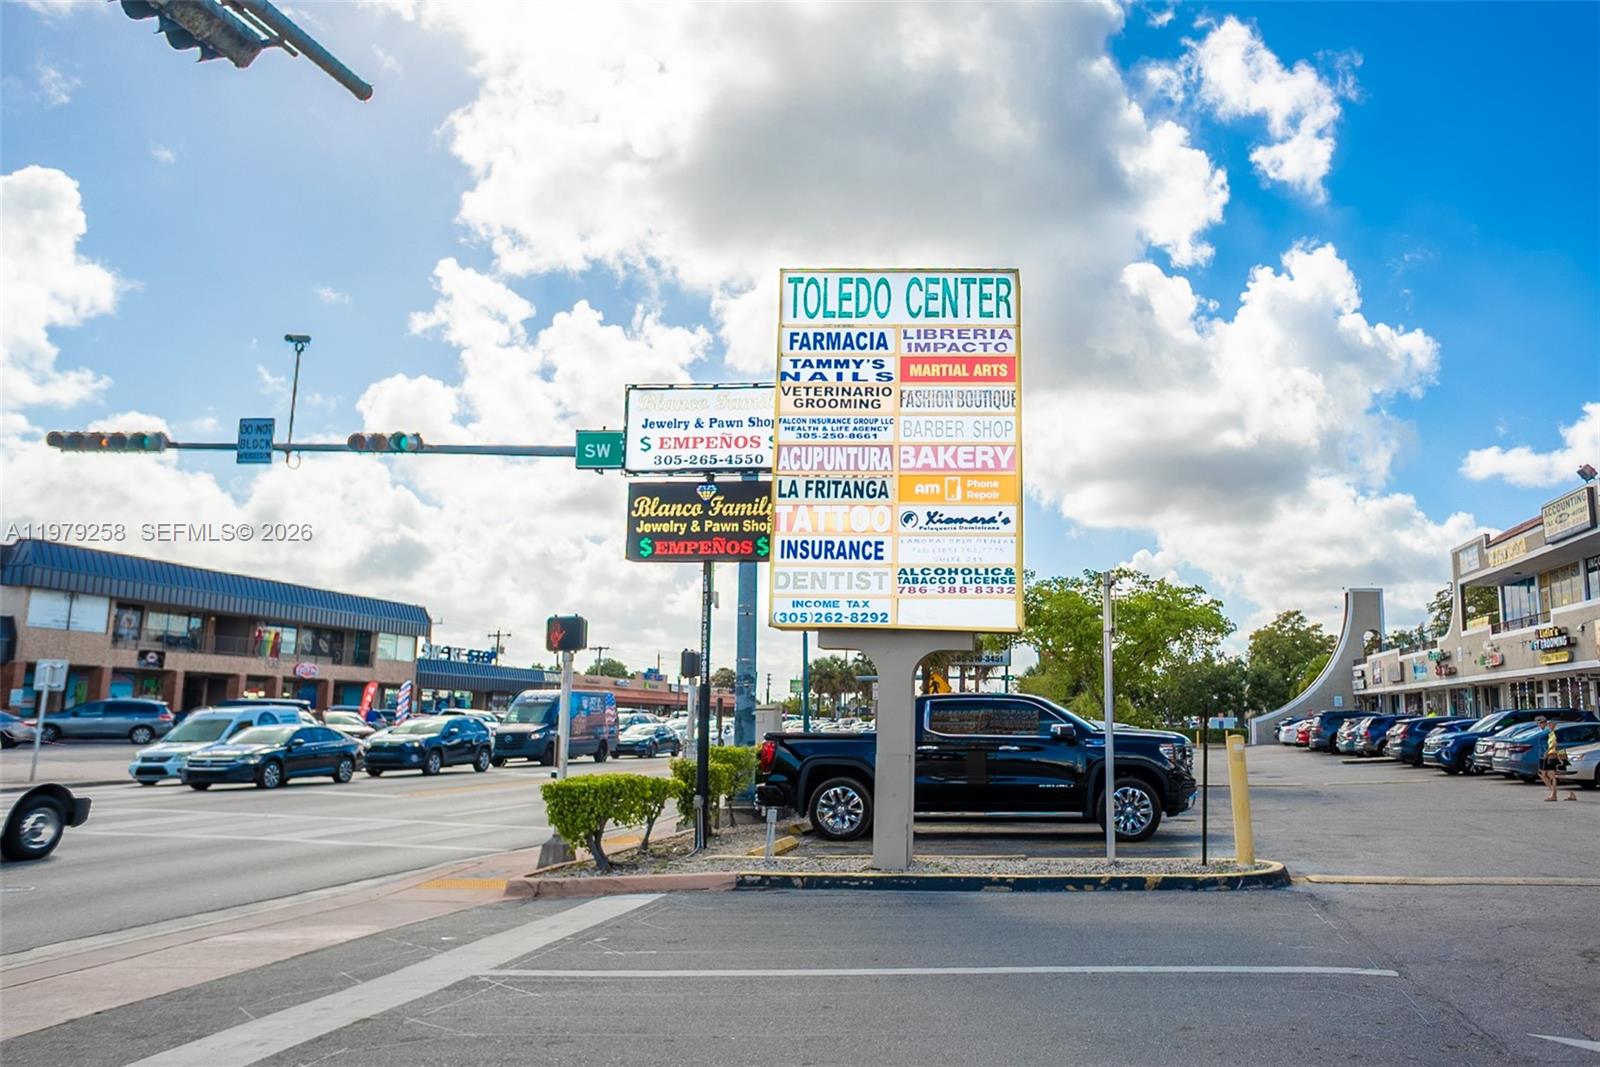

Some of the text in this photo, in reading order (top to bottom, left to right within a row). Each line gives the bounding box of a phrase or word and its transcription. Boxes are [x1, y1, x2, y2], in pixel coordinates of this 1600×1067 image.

[788, 277, 1012, 319] TOLEDO CENTER
[789, 331, 889, 350] FARMACIA
[902, 328, 1013, 340] LIBRERIA
[907, 342, 1008, 353] IMPACTO
[790, 358, 886, 369] TAMMY'S
[910, 364, 1008, 376] MARTIAL ARTS
[780, 372, 894, 382] NAILS
[781, 386, 892, 397] VETERINARIO
[637, 393, 774, 412] Blanco Famil
[794, 398, 882, 409] GROOMING
[900, 389, 1016, 410] FASHION BOUTIQUE
[240, 424, 274, 435] DO NOT
[642, 418, 690, 430] Jewelry
[694, 418, 704, 429] &
[708, 417, 744, 428] Pawn
[903, 420, 1014, 438] BARBER SHOP
[240, 439, 272, 450] BLOCK
[640, 436, 652, 452] $
[658, 432, 762, 450] EMPEÑOS
[584, 444, 611, 458] SW
[900, 446, 1014, 469] BAKERY
[654, 454, 764, 466] 305-265-4550
[778, 447, 892, 471] ACUPUNTURA
[778, 480, 889, 498] LA FRITANGA
[967, 480, 999, 488] Phone
[967, 491, 1000, 500] Repair
[632, 496, 704, 517] Blanco
[1544, 491, 1587, 518] ACCOUNTING
[776, 506, 892, 532] TATTOO
[926, 511, 1012, 526] Xiomara's
[636, 520, 686, 534] Jewelry
[690, 520, 701, 532] &
[704, 520, 740, 532] Pawn
[640, 536, 770, 557] $ EMPEÑOS $
[780, 540, 884, 561] INSURANCE
[898, 568, 1015, 576] ALCOHOLIC&
[775, 572, 889, 590] DENTIST
[898, 586, 1016, 594] 786-388-8332
[792, 600, 870, 608] INCOME TAX
[773, 612, 889, 624] (305)262-8292
